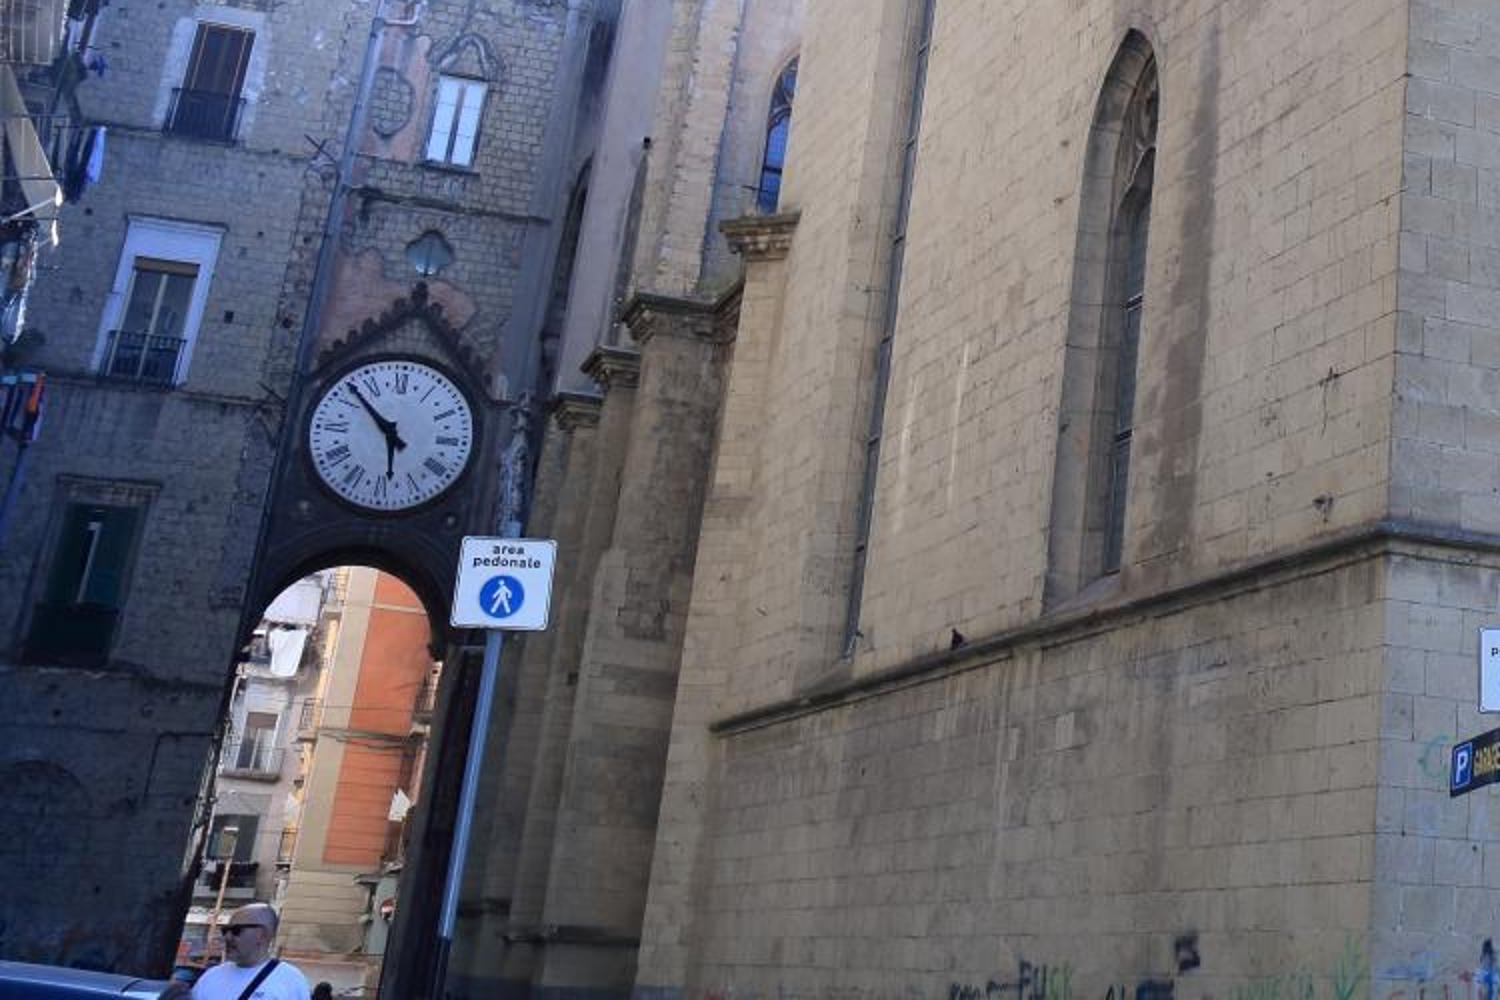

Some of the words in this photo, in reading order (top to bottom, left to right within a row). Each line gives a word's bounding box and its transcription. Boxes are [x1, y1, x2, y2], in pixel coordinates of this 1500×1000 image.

[493, 545, 525, 554] area
[473, 556, 542, 568] pedonale
[1455, 753, 1468, 783] P
